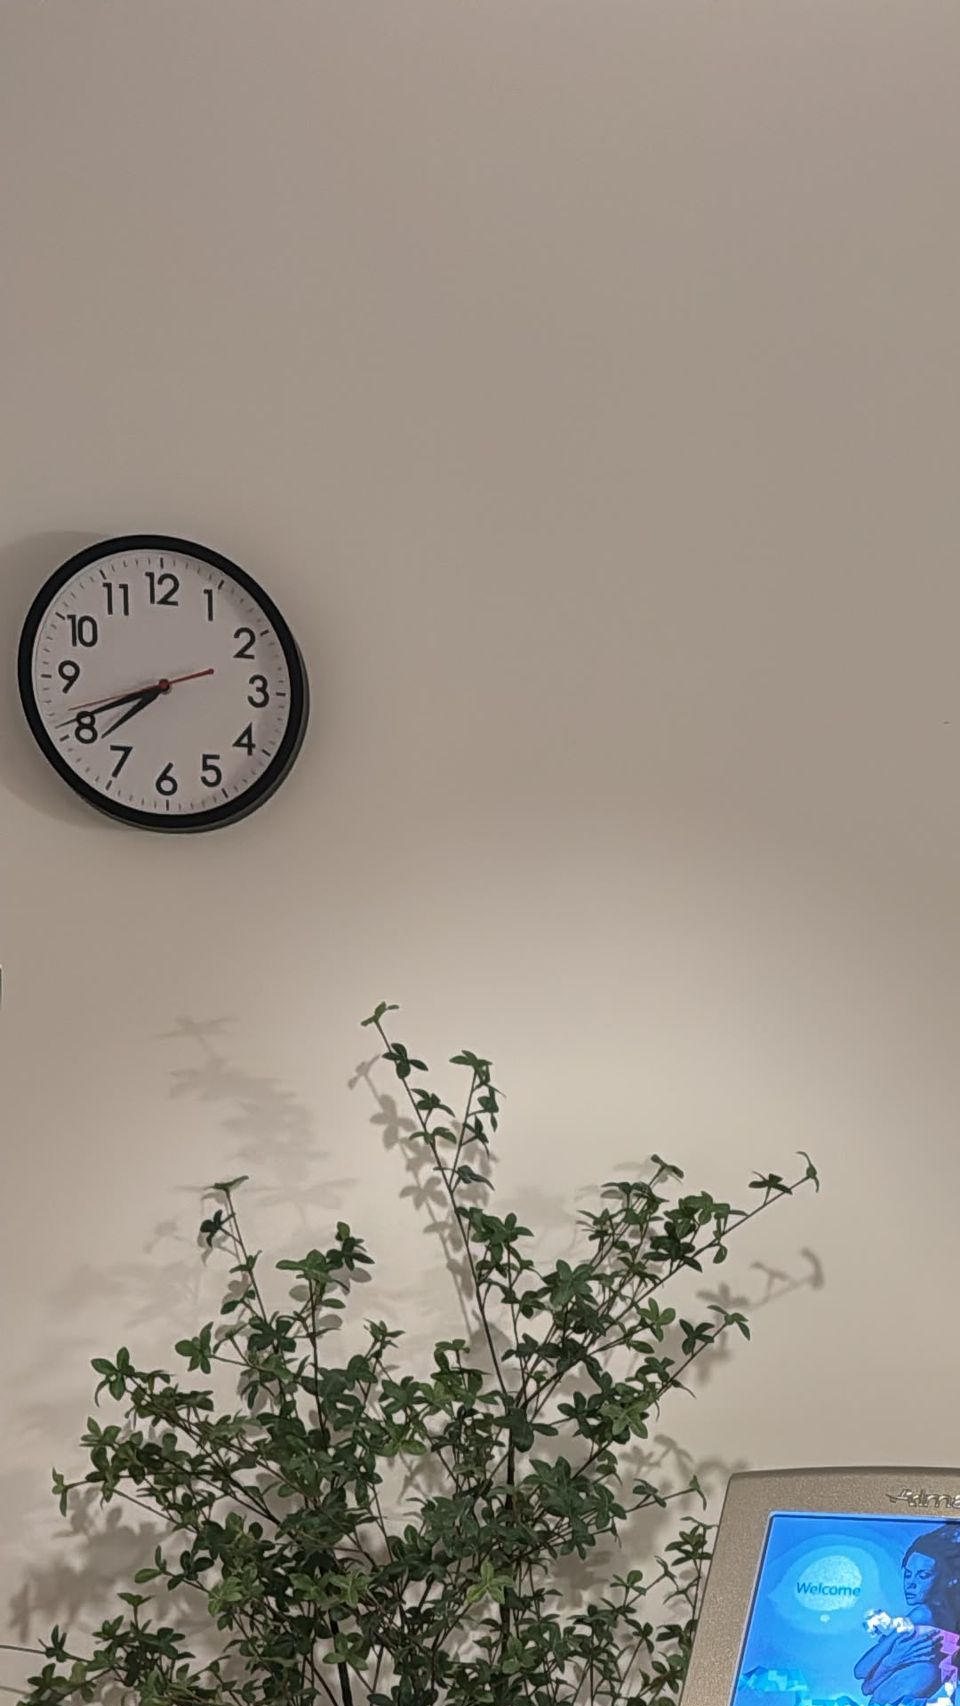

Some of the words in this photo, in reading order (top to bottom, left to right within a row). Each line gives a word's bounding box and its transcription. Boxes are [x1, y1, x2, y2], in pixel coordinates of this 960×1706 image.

[102, 582, 130, 616] 11
[145, 571, 180, 606] 12
[203, 588, 214, 621] 1
[66, 614, 98, 648] 10
[232, 626, 256, 660] 2
[57, 660, 81, 694] 9
[247, 674, 270, 708] 3
[74, 710, 98, 744] 8
[231, 722, 256, 756] 4
[109, 745, 133, 778] 7
[200, 754, 223, 788] 5
[155, 762, 178, 796] 6
[796, 1581, 861, 1597] Welcome
